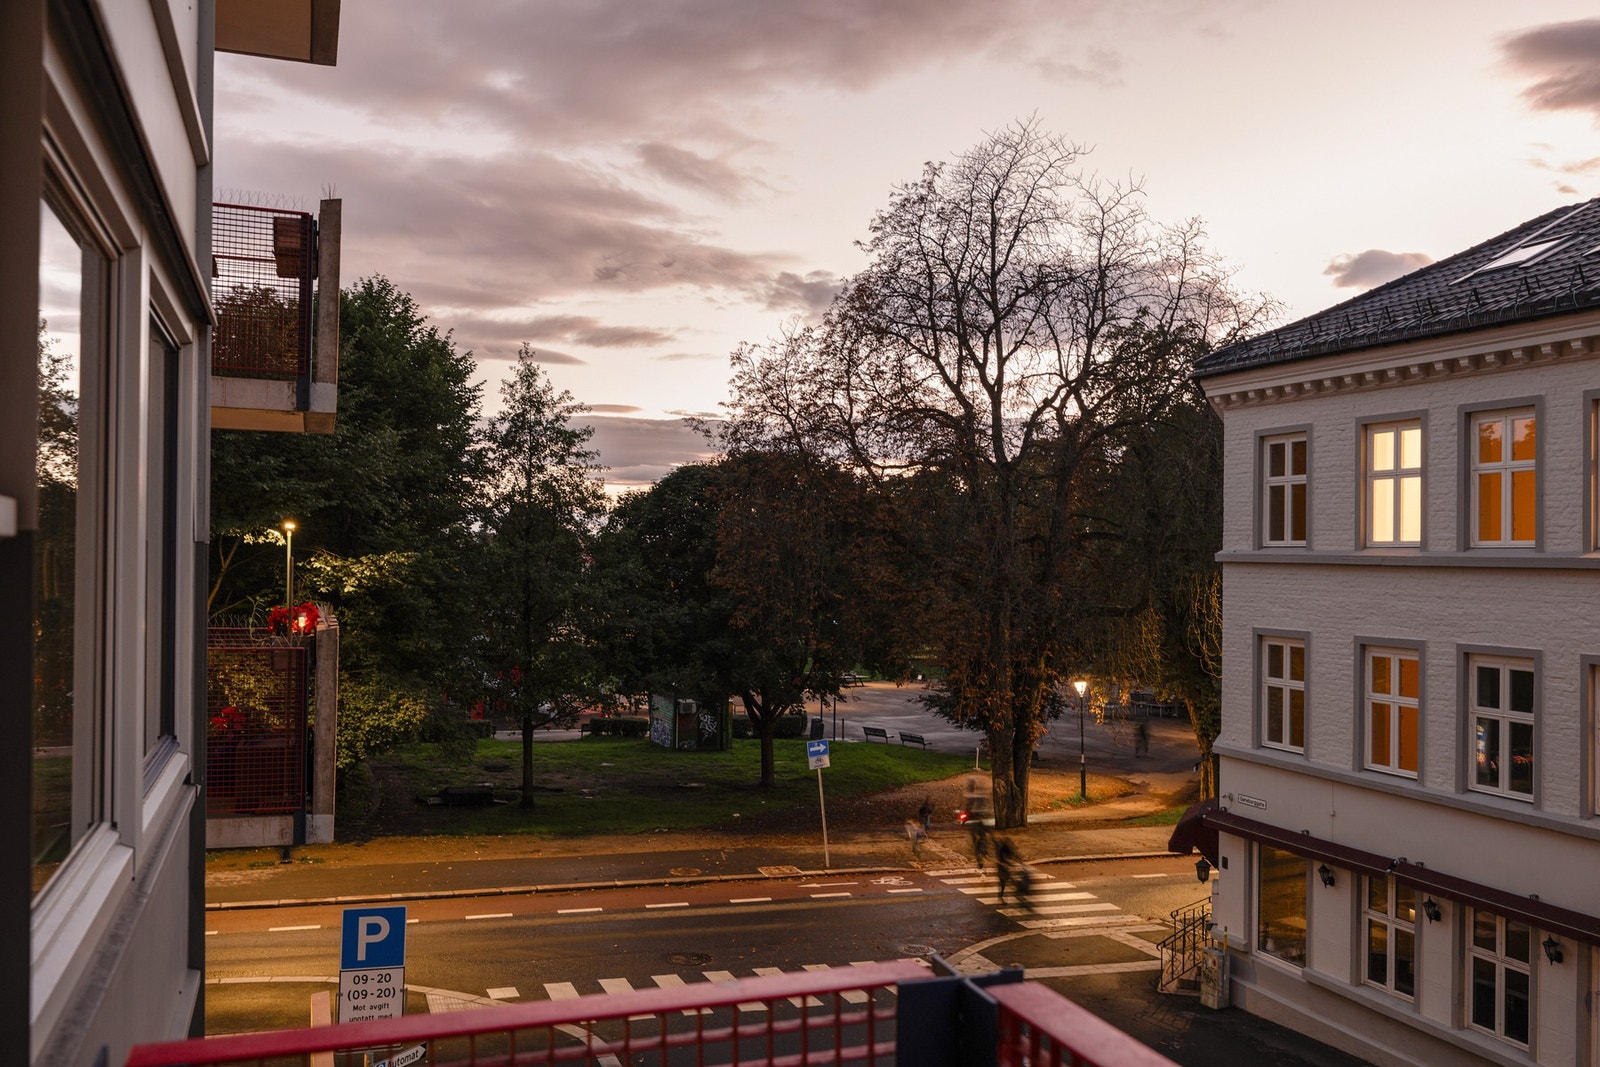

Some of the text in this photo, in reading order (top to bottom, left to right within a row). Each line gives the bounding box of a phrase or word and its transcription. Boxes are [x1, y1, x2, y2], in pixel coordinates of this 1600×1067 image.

[356, 916, 390, 960] P
[352, 1003, 390, 1012] Mot avgift
